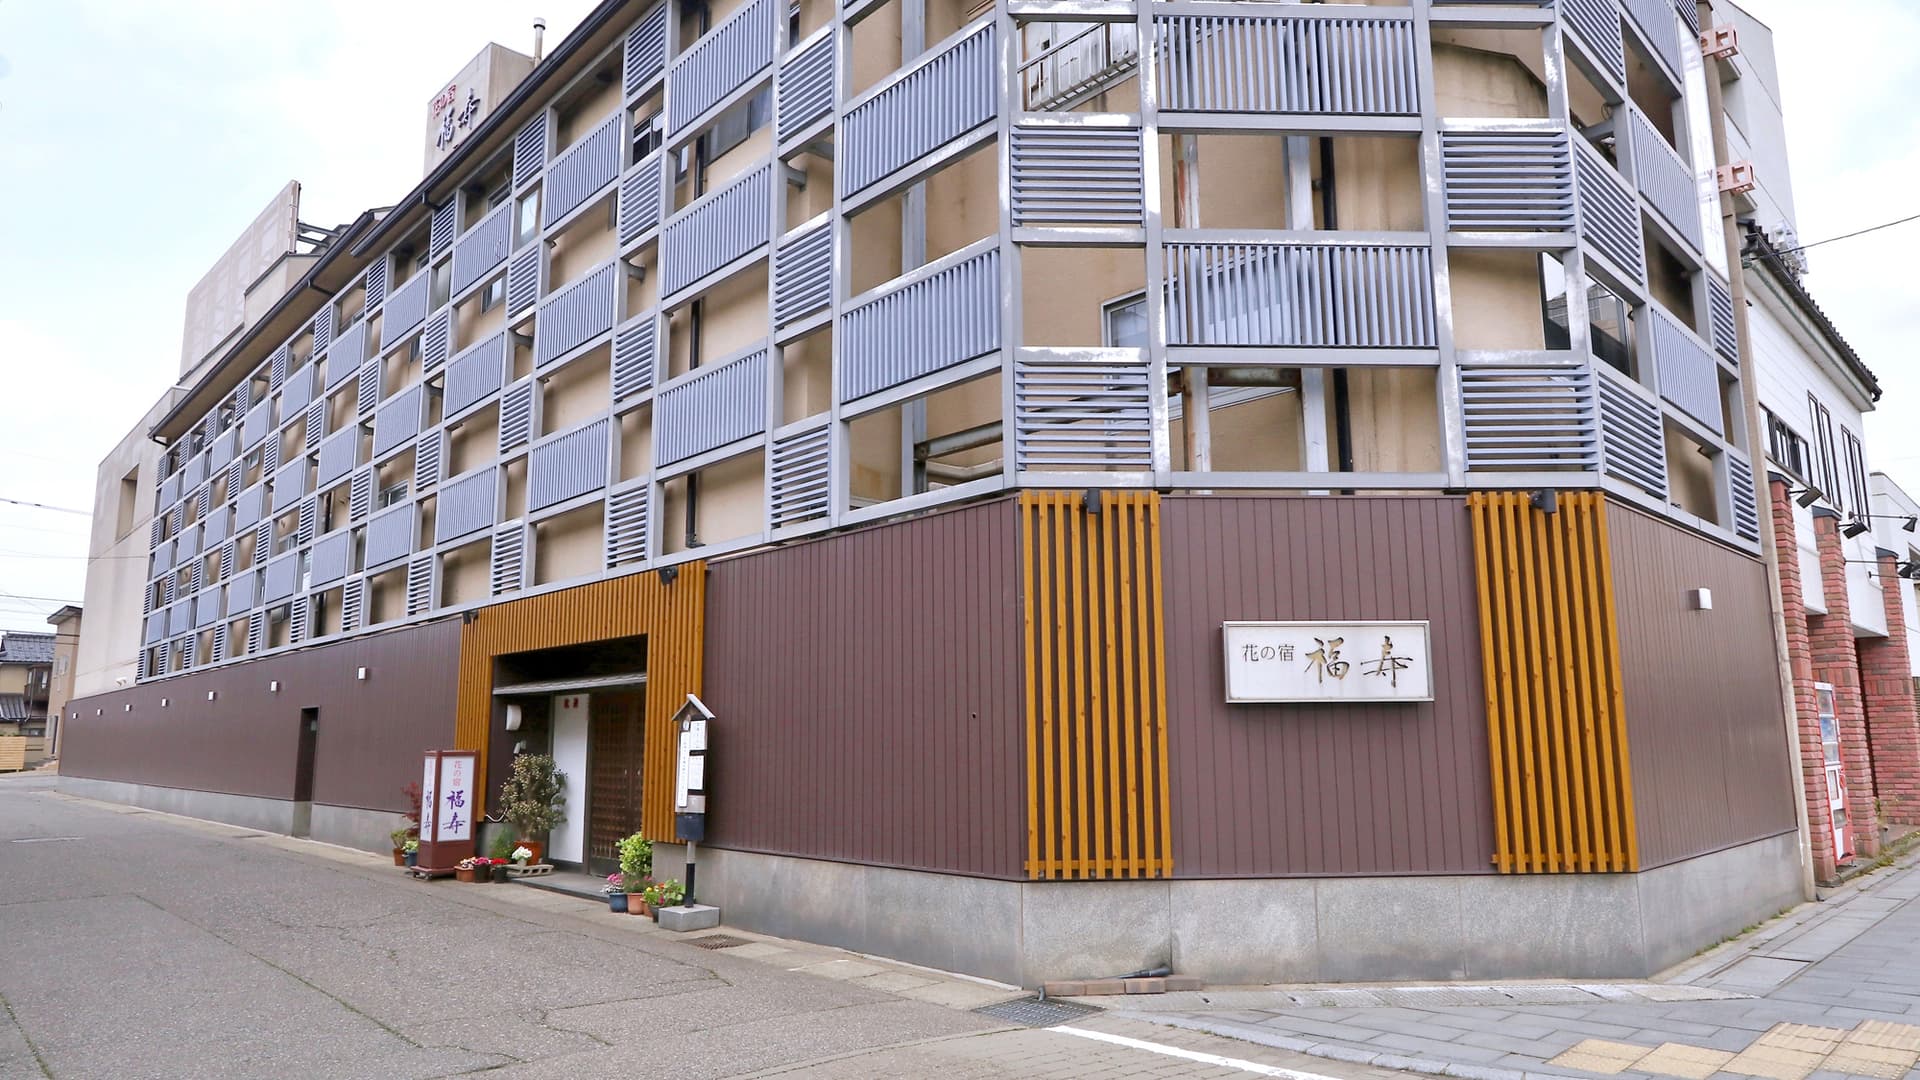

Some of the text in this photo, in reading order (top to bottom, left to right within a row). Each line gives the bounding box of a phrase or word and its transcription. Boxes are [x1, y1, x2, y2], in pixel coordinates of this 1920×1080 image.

[1242, 635, 1414, 688] 花の宿 福寿
